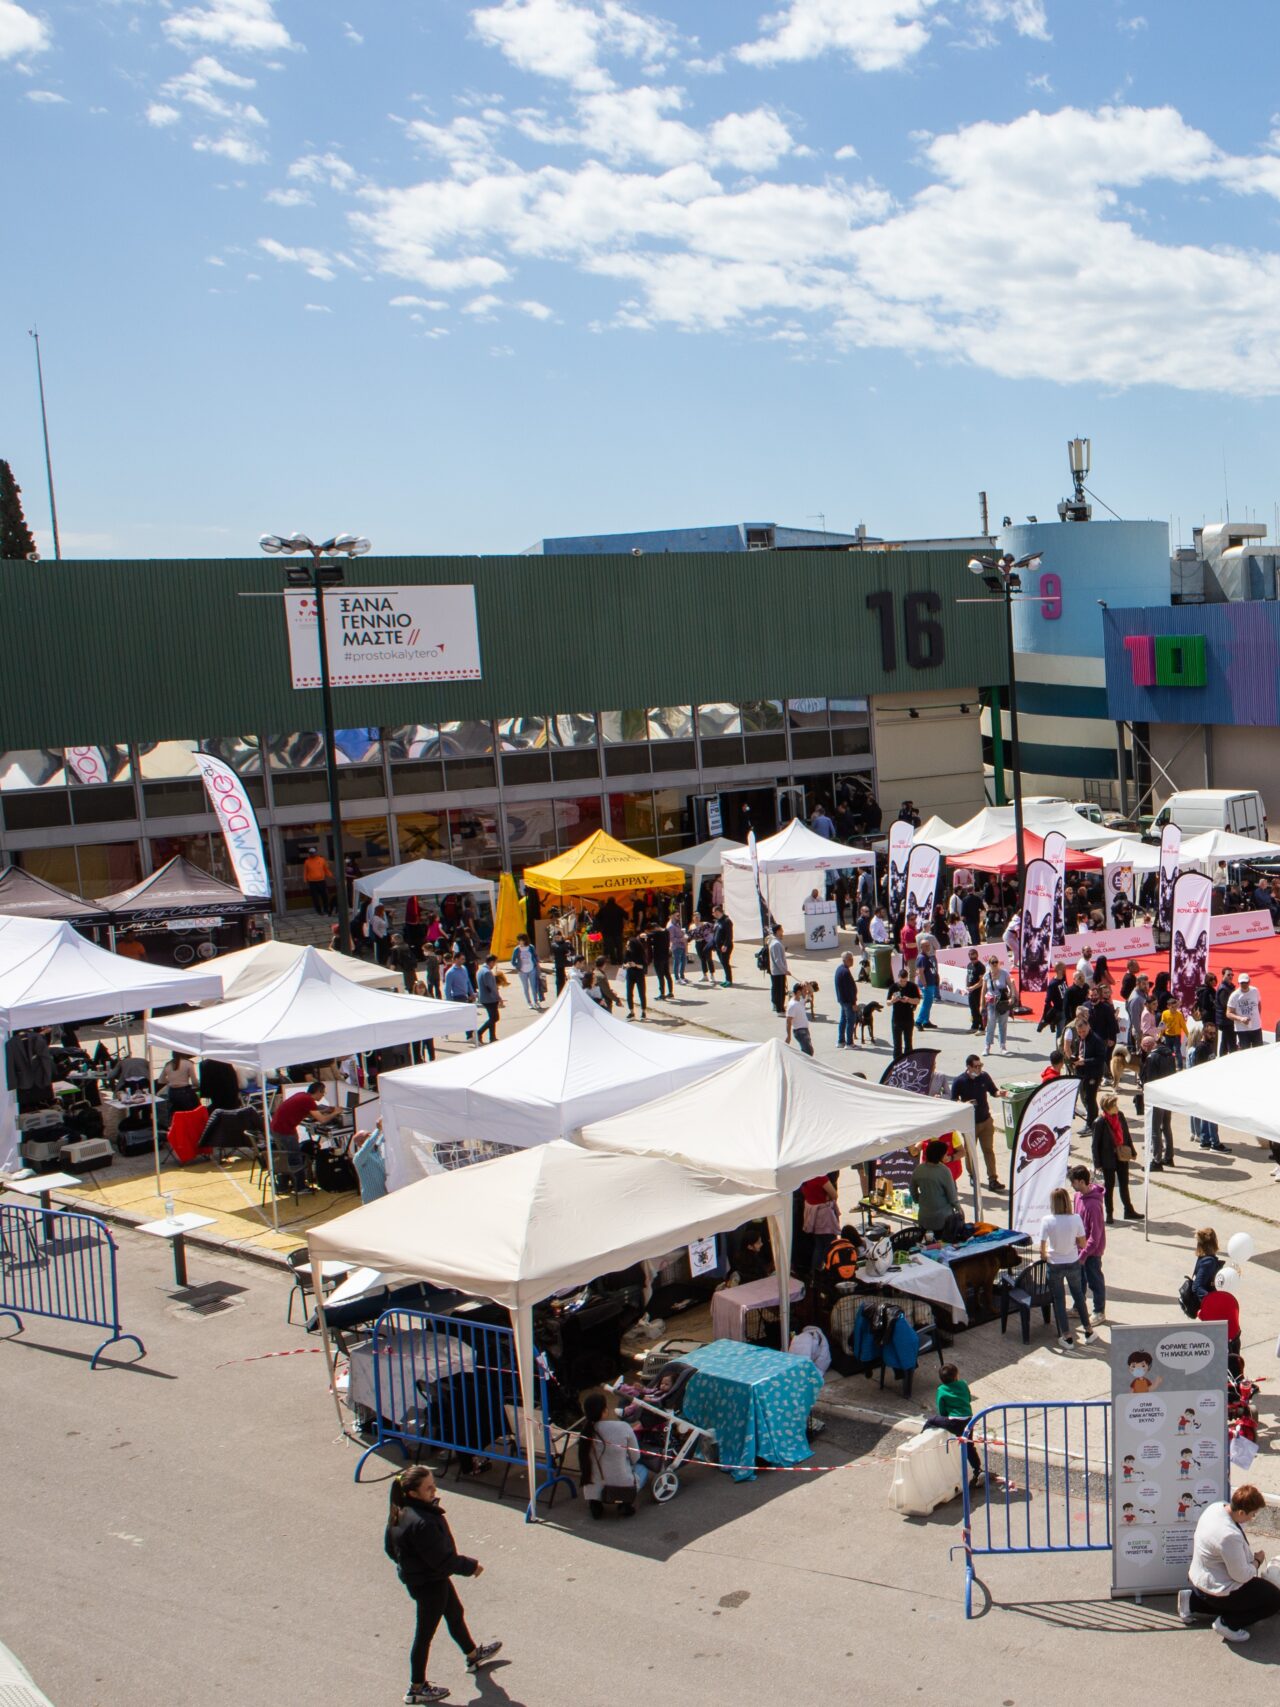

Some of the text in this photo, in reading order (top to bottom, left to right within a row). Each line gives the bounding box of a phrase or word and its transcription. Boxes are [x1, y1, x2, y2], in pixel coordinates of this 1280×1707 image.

[1040, 573, 1061, 620] 9
[340, 598, 394, 613] ΞΑΝΑ
[342, 613, 412, 630] ΓΕΝΝΙΟ
[343, 630, 404, 647] ΜΑΣΤΕ
[866, 590, 946, 673] 16
[344, 648, 439, 662] #prostokalytero
[1124, 634, 1208, 687] 10
